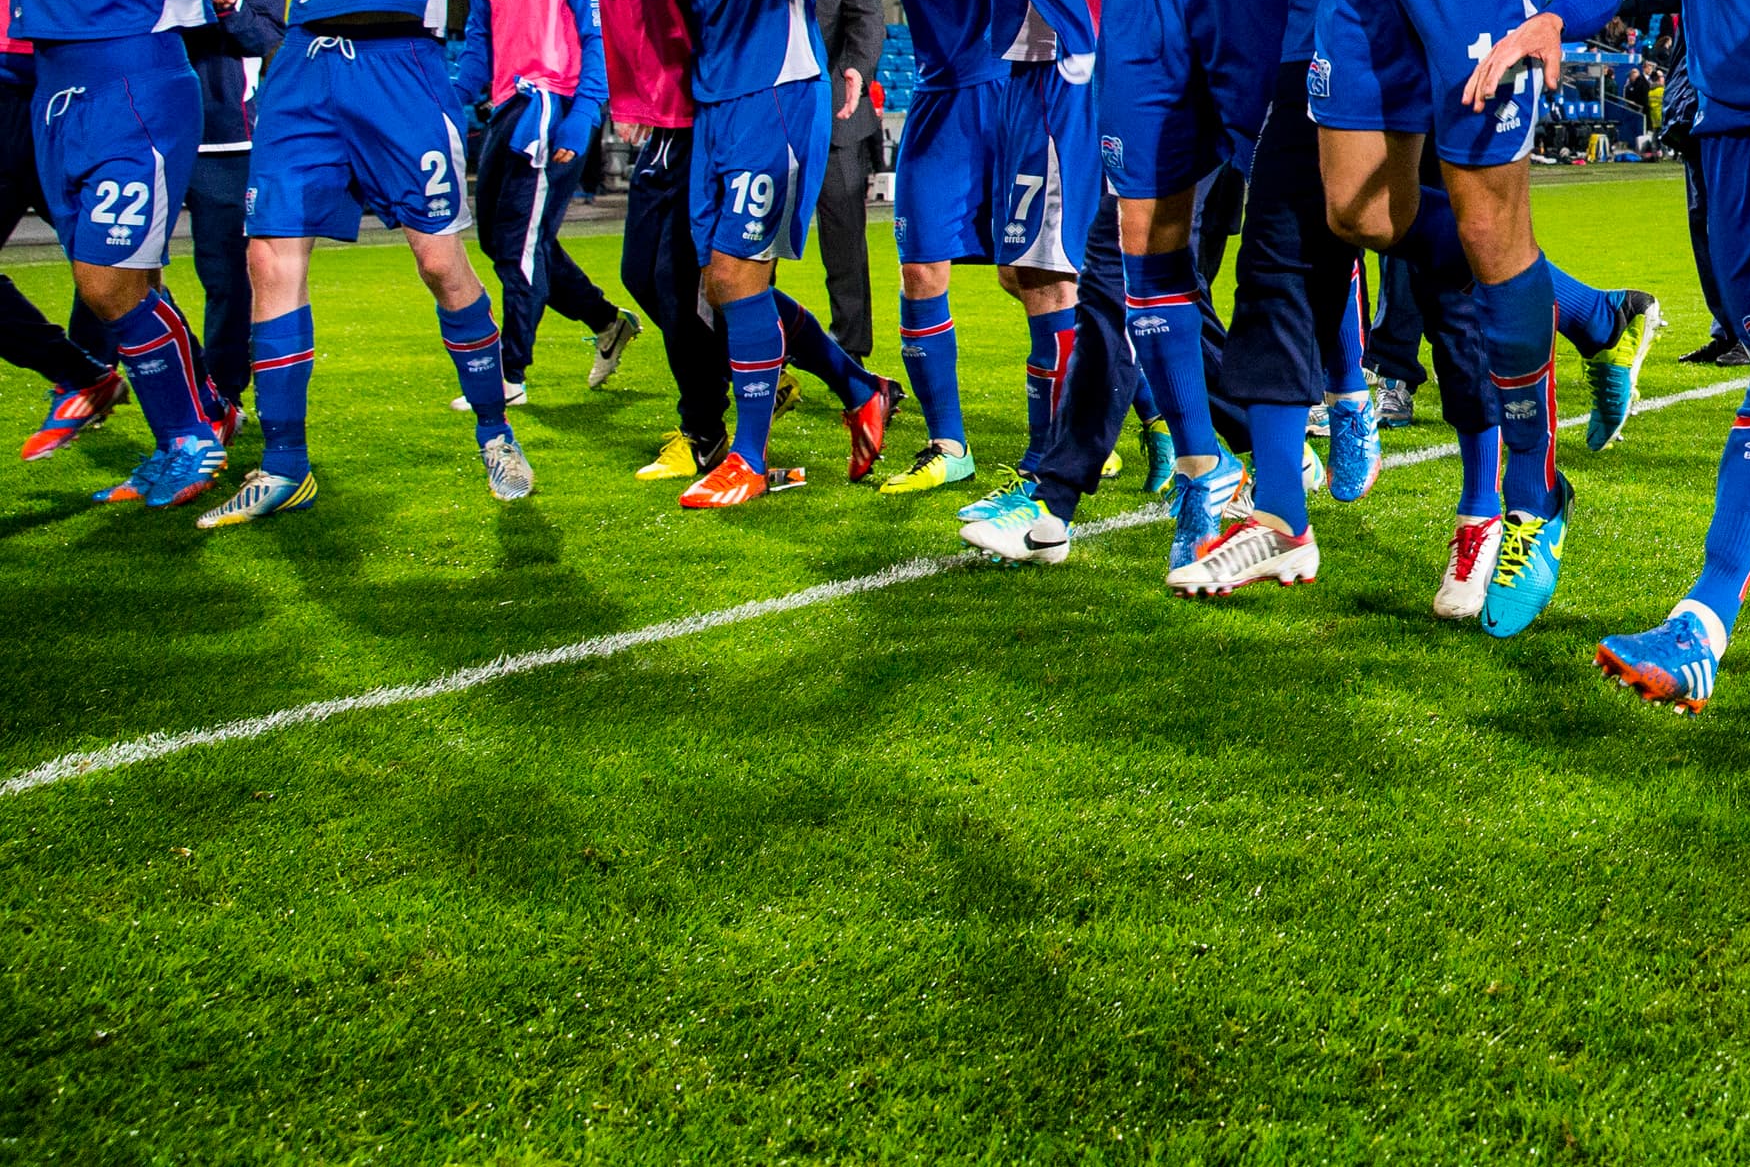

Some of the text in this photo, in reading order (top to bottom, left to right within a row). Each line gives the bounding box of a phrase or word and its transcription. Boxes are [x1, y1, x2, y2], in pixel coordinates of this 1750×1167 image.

[1496, 117, 1521, 133] errea
[421, 150, 452, 197] 2
[731, 171, 775, 218] 19
[1014, 173, 1044, 221] 7
[91, 180, 150, 226] 22
